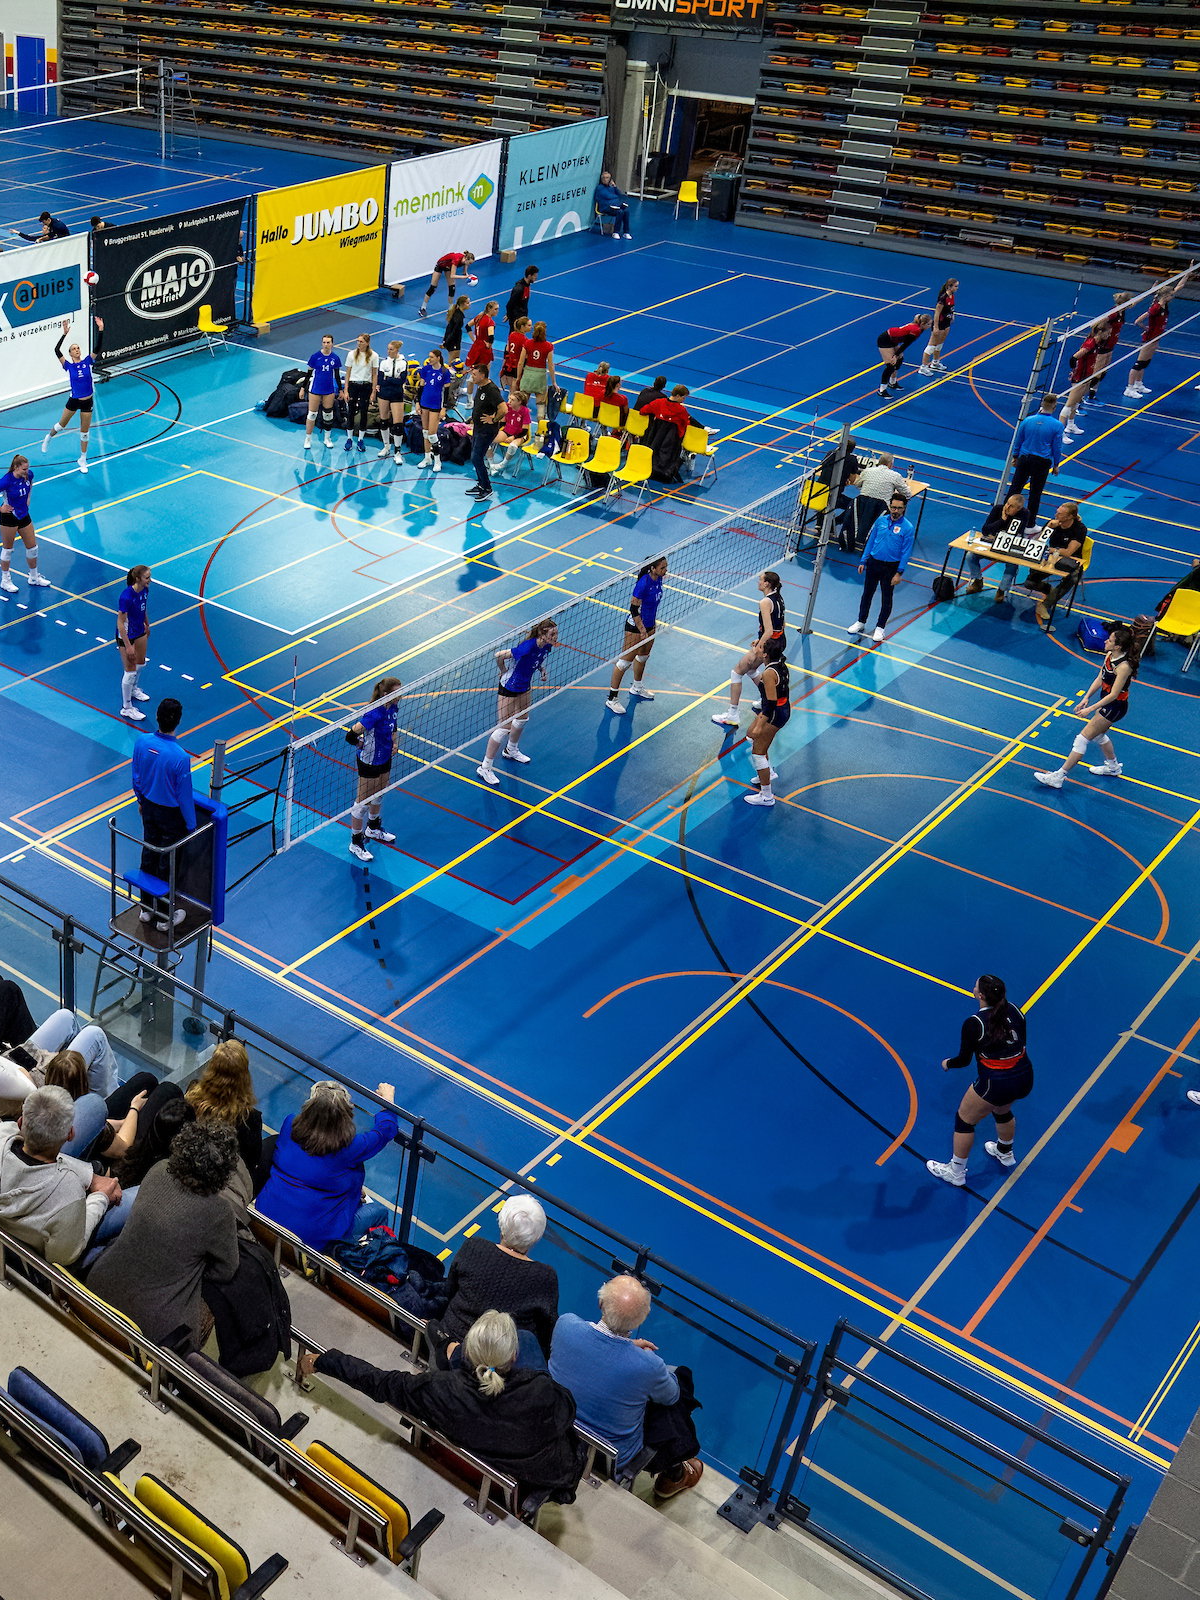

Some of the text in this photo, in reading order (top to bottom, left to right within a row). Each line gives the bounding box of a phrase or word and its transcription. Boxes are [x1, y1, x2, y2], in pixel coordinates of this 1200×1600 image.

[615, 0, 763, 19] OMNISPORT
[519, 154, 591, 187] KLEIN OPTIEK
[393, 181, 466, 218] mennink
[517, 186, 588, 213] ZIEN IS BELEVEN
[260, 197, 380, 246] Hallo JUMBO
[339, 229, 378, 250] Wiegmans
[141, 258, 206, 302] MAJO
[19, 277, 74, 303] advies
[140, 292, 180, 310] verse friet
[10, 332, 17, 340] &
[510, 342, 515, 354] 2
[533, 350, 540, 360] 9
[321, 364, 330, 372] 14
[429, 378, 435, 386] 4
[1011, 520, 1019, 532] 8
[997, 536, 1011, 550] 18
[1025, 543, 1043, 558] 23
